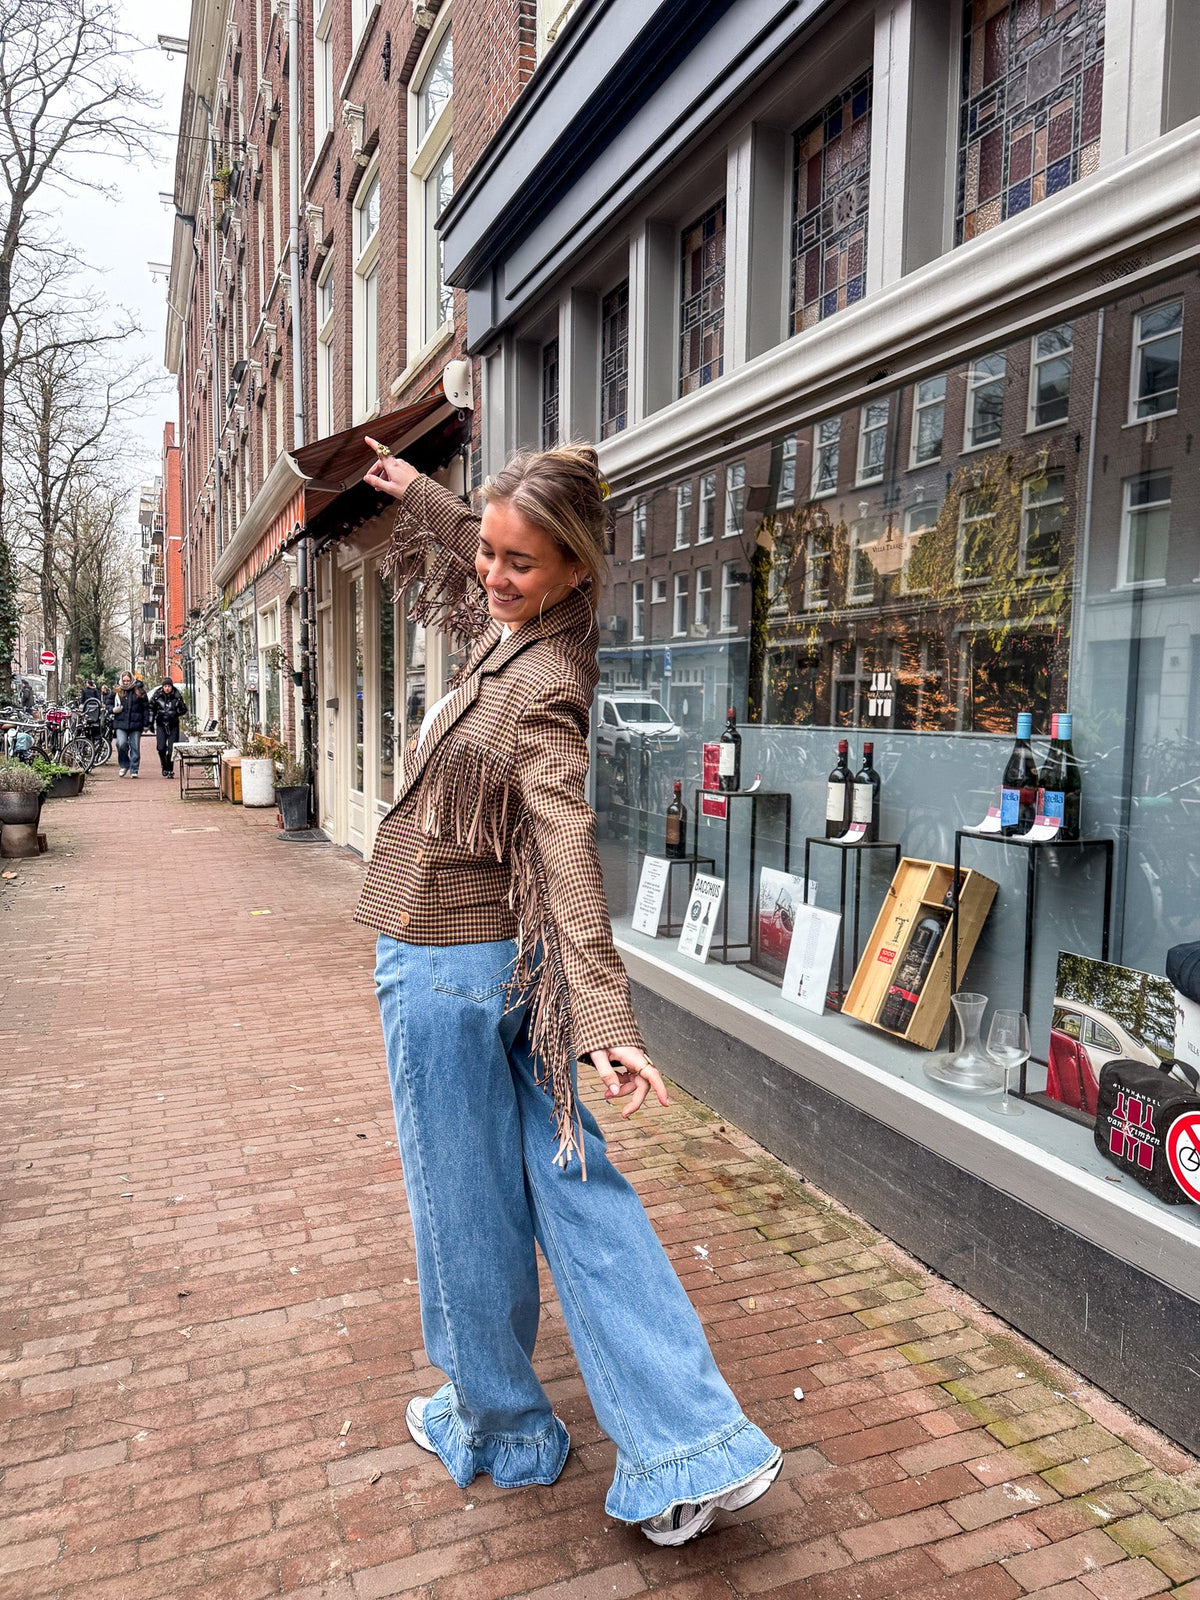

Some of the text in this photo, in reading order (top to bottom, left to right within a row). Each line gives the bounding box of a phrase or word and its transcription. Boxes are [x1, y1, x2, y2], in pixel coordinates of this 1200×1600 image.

[695, 878, 721, 898] BACCHUS
[1112, 1083, 1161, 1107] WIJNHANDEL
[1107, 1116, 1160, 1146] van Krimpen
